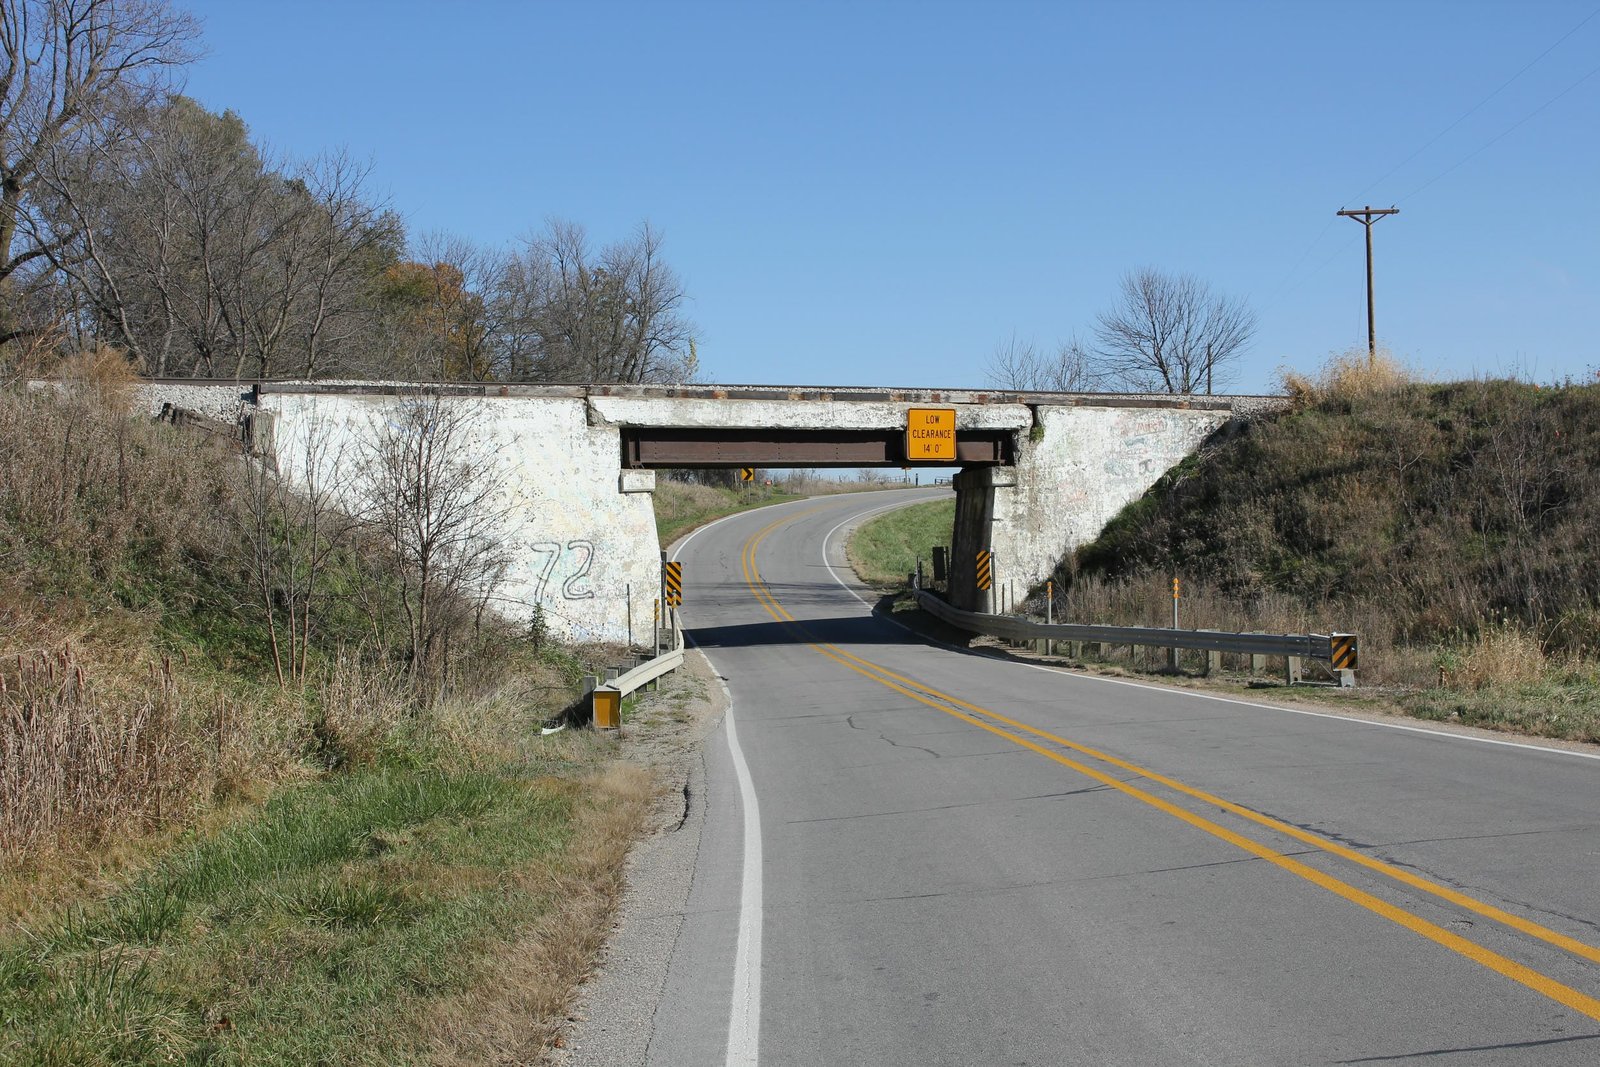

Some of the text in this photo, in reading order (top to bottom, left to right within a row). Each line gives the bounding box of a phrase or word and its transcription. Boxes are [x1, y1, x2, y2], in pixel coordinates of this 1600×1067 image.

[926, 415, 940, 424] LOW
[912, 429, 951, 439] CLEARANCE
[530, 540, 595, 604] 72
